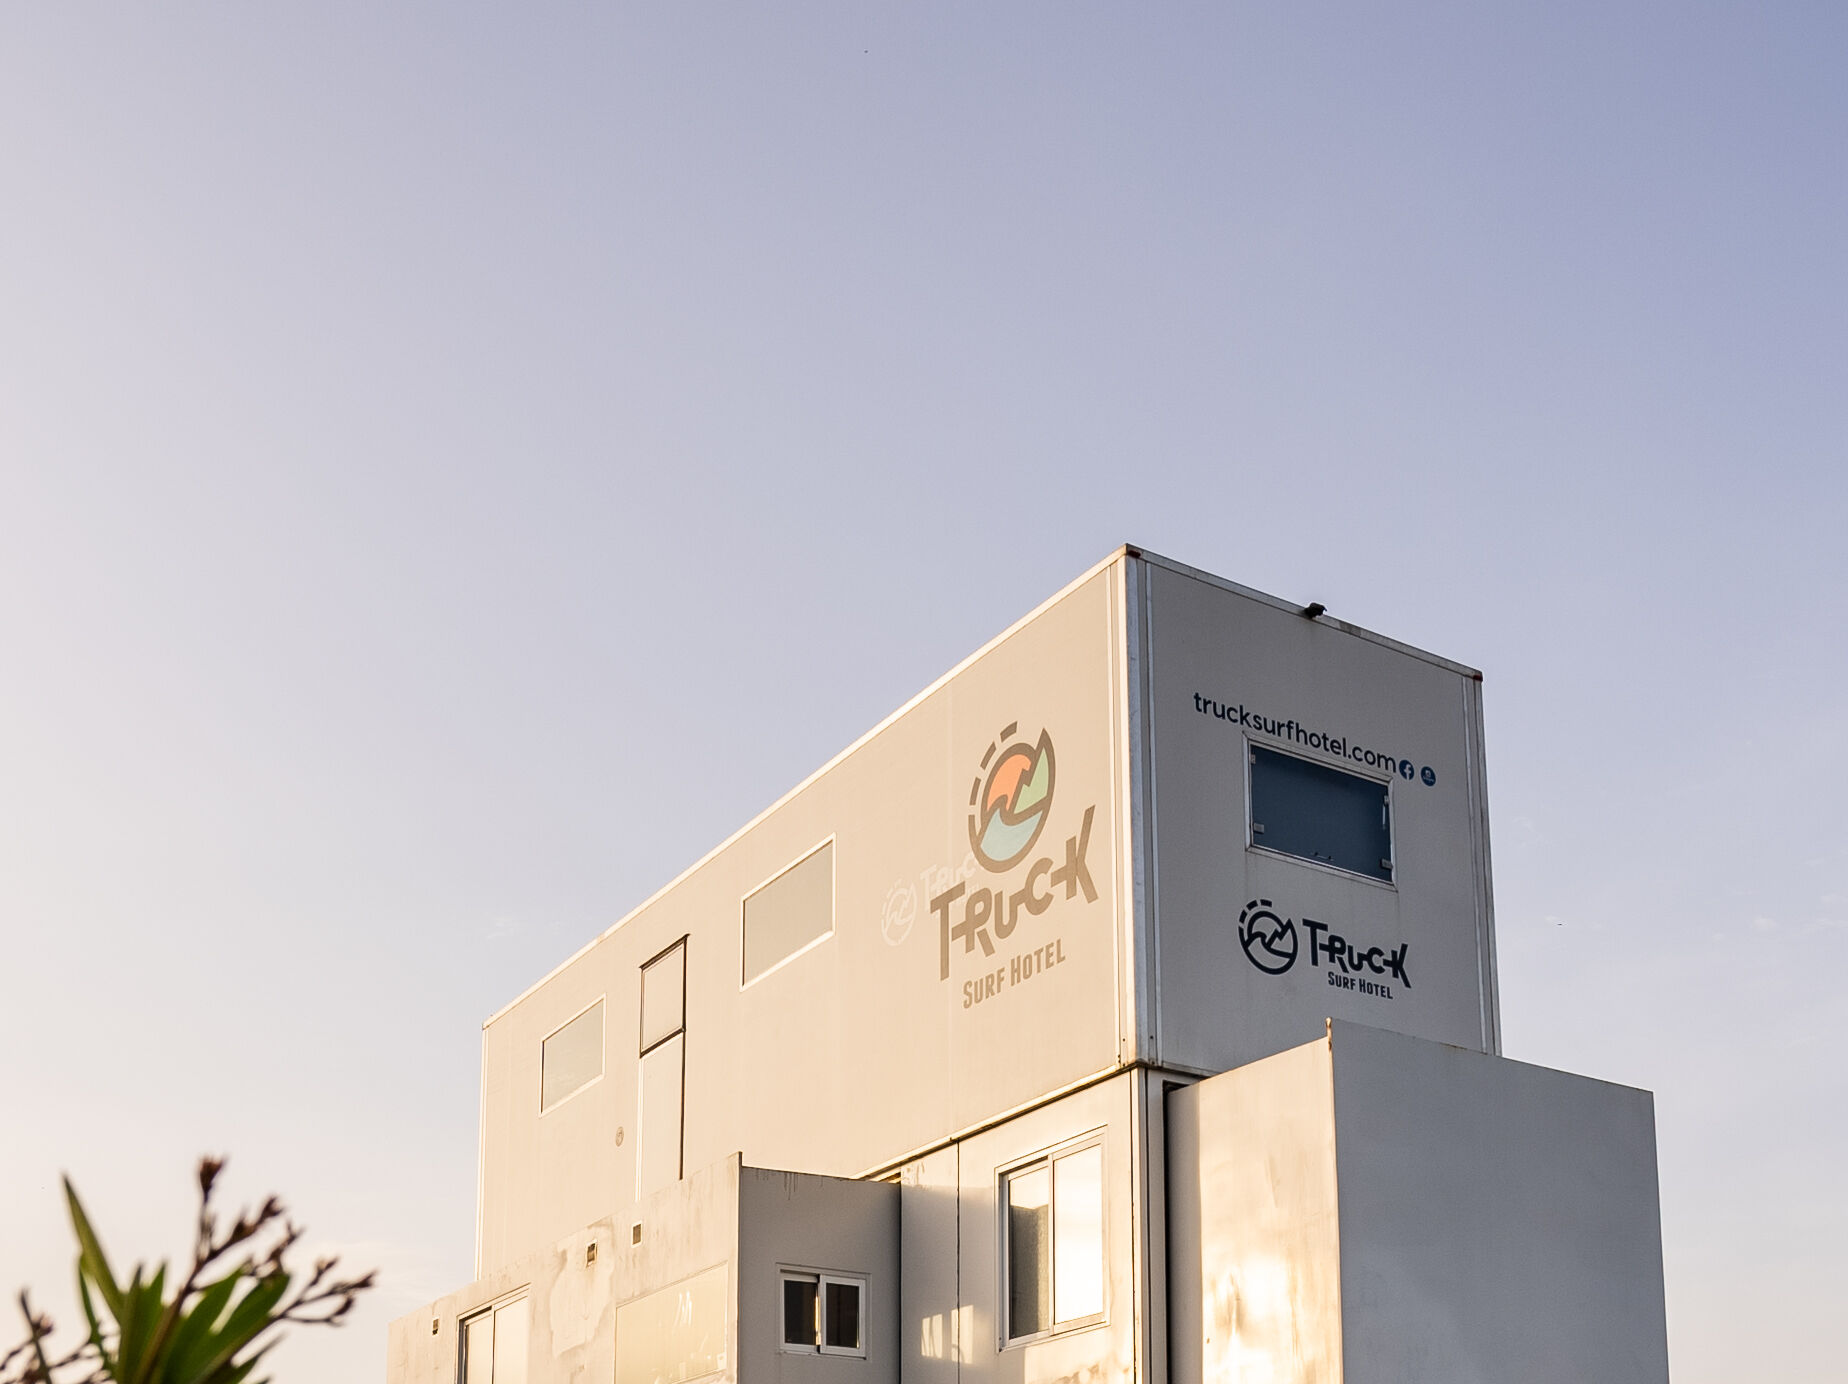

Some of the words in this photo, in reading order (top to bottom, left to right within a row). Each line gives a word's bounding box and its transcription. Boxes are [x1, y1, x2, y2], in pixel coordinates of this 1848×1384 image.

[1193, 692, 1397, 773] trucksurfhotel.com
[963, 967, 1006, 1009] SURF
[1010, 938, 1066, 987] HOTEL
[1327, 971, 1356, 991] SURF
[1358, 978, 1394, 1000] HOTEL
